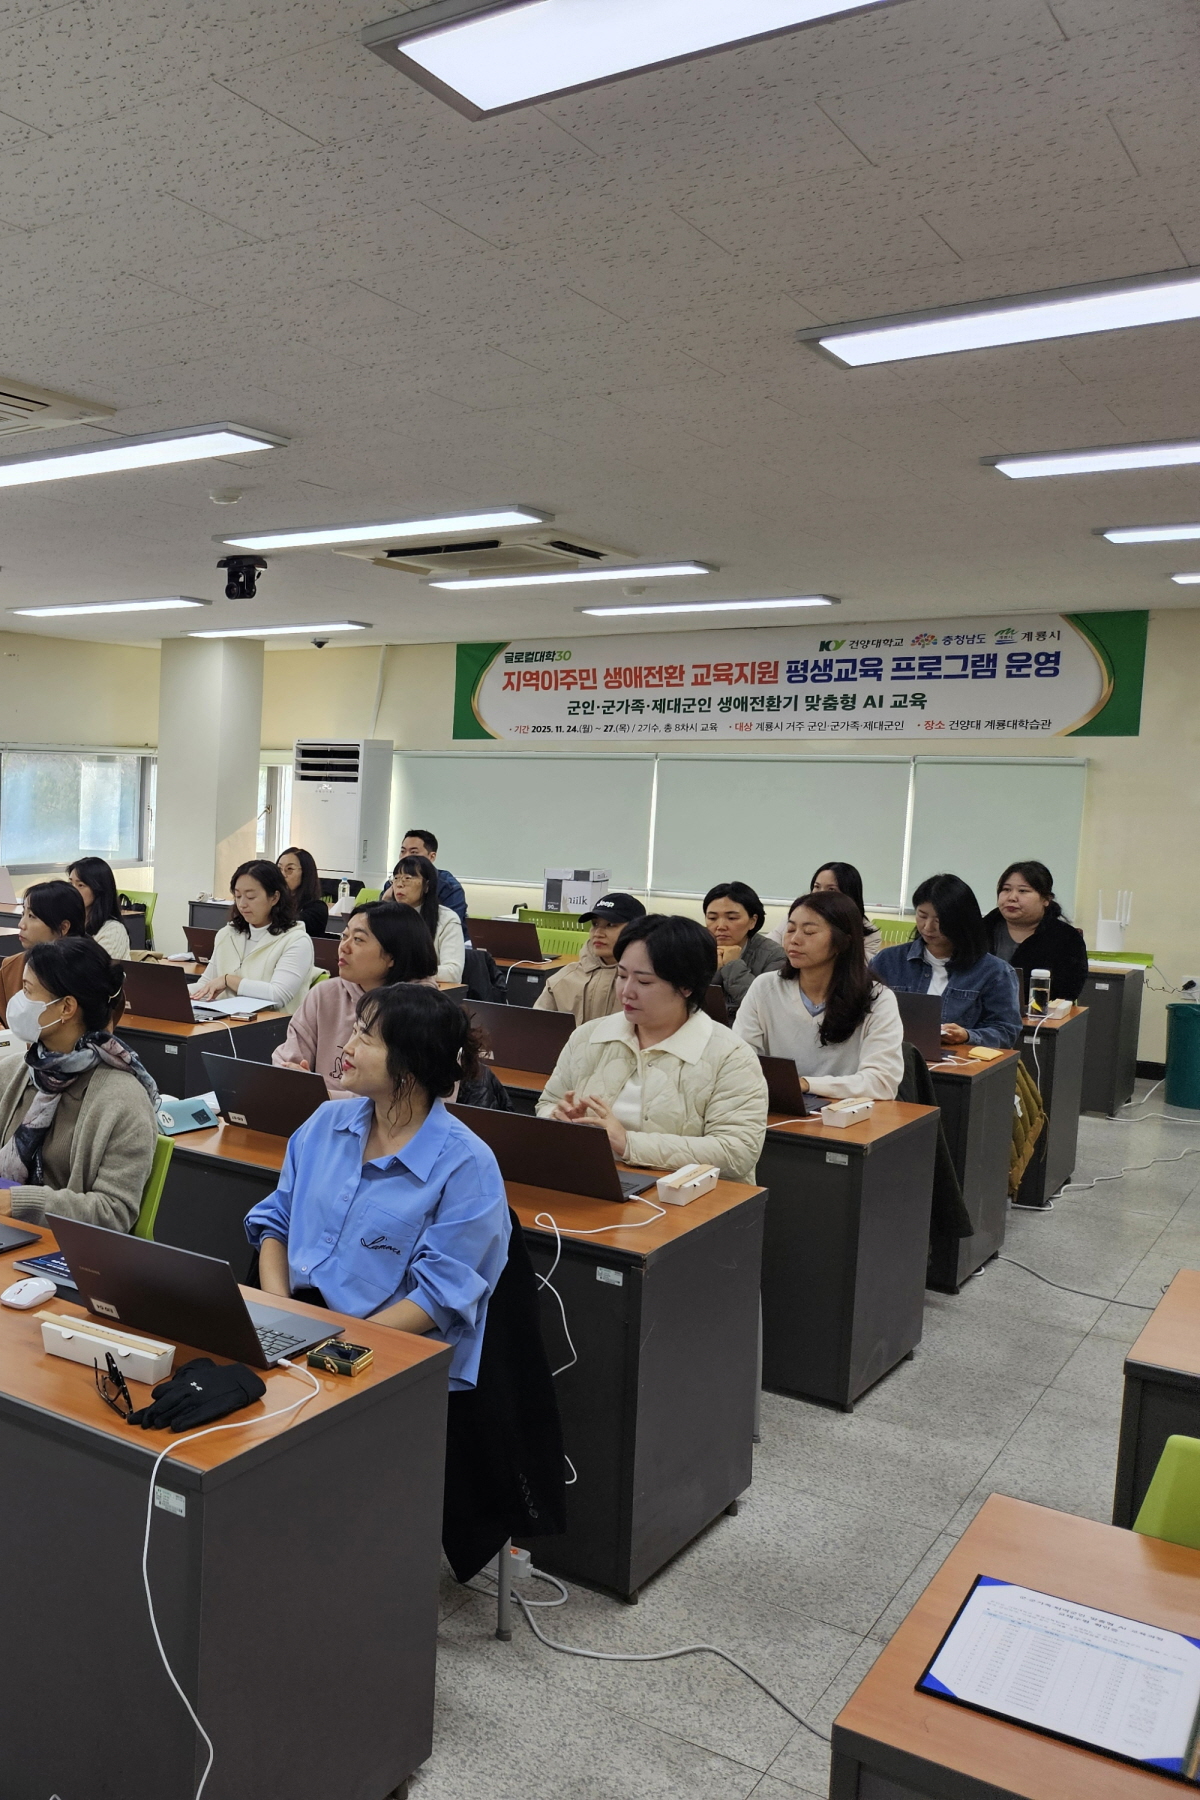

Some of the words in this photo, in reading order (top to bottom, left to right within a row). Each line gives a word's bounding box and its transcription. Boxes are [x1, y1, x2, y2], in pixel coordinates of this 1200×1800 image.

[941, 633, 987, 646] 충청남도
[1021, 630, 1061, 642] 계룡시
[849, 638, 904, 650] 건양대학교
[504, 650, 572, 664] 글로컬대학30
[502, 668, 598, 692] 지역이주민
[603, 664, 685, 690] 생애전환
[691, 660, 779, 687] 교육지원
[786, 657, 884, 684] 평생교육
[890, 653, 998, 681] 프로그램
[1005, 650, 1061, 679] 운영
[567, 696, 712, 716] 군인·군가족·제대군인
[717, 694, 799, 713] 생애전환기
[805, 693, 857, 711] 맞춤형
[862, 694, 884, 709] AI
[890, 692, 928, 710] 교육
[514, 725, 530, 734] 기간
[531, 725, 554, 734] 2025.
[555, 725, 565, 734] 11.
[638, 723, 662, 734] 2기수,
[663, 723, 673, 733] 총
[674, 722, 698, 733] 8차시
[700, 722, 718, 733] 교육
[735, 722, 753, 732] 대상
[755, 721, 783, 732] 계룡시
[785, 720, 805, 732] 거주
[807, 720, 905, 732] 군인·군가족·제대군인
[923, 720, 946, 731] 장소
[948, 719, 981, 731] 건양대
[984, 718, 1052, 731] 계룡대학습관
[597, 900, 615, 908] Jeep
